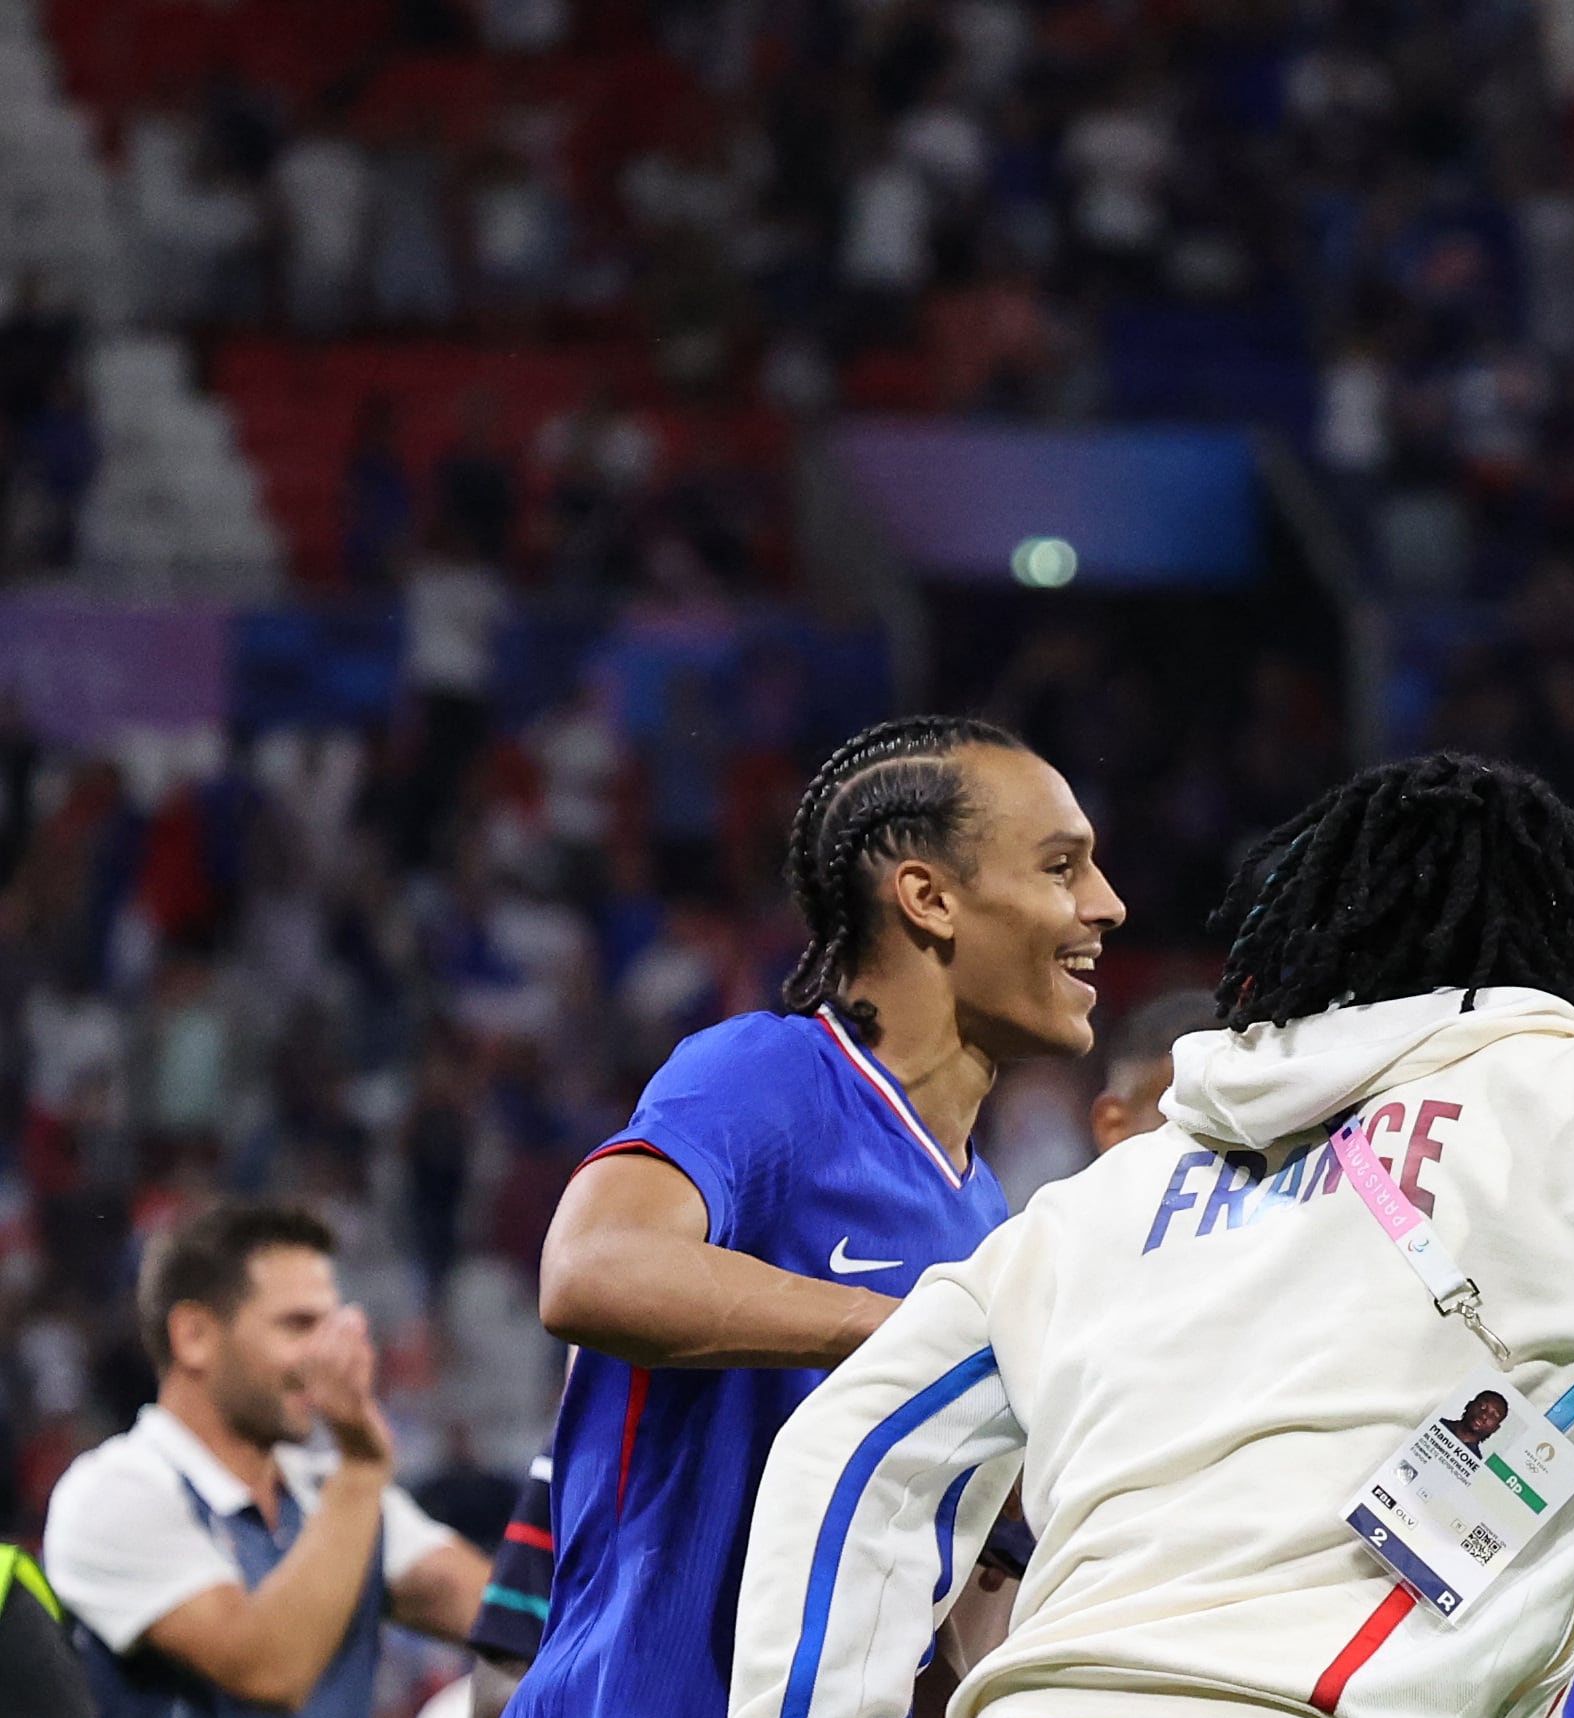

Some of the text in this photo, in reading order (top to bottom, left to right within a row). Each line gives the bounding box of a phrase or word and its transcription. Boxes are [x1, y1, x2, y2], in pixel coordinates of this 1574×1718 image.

[1365, 1174, 1408, 1227] PARIS
[1429, 1424, 1454, 1449] Manu
[1373, 1488, 1395, 1508] FBL
[1395, 1508, 1415, 1527] OLV
[1369, 1527, 1388, 1548] 2
[1436, 1590, 1456, 1613] R
